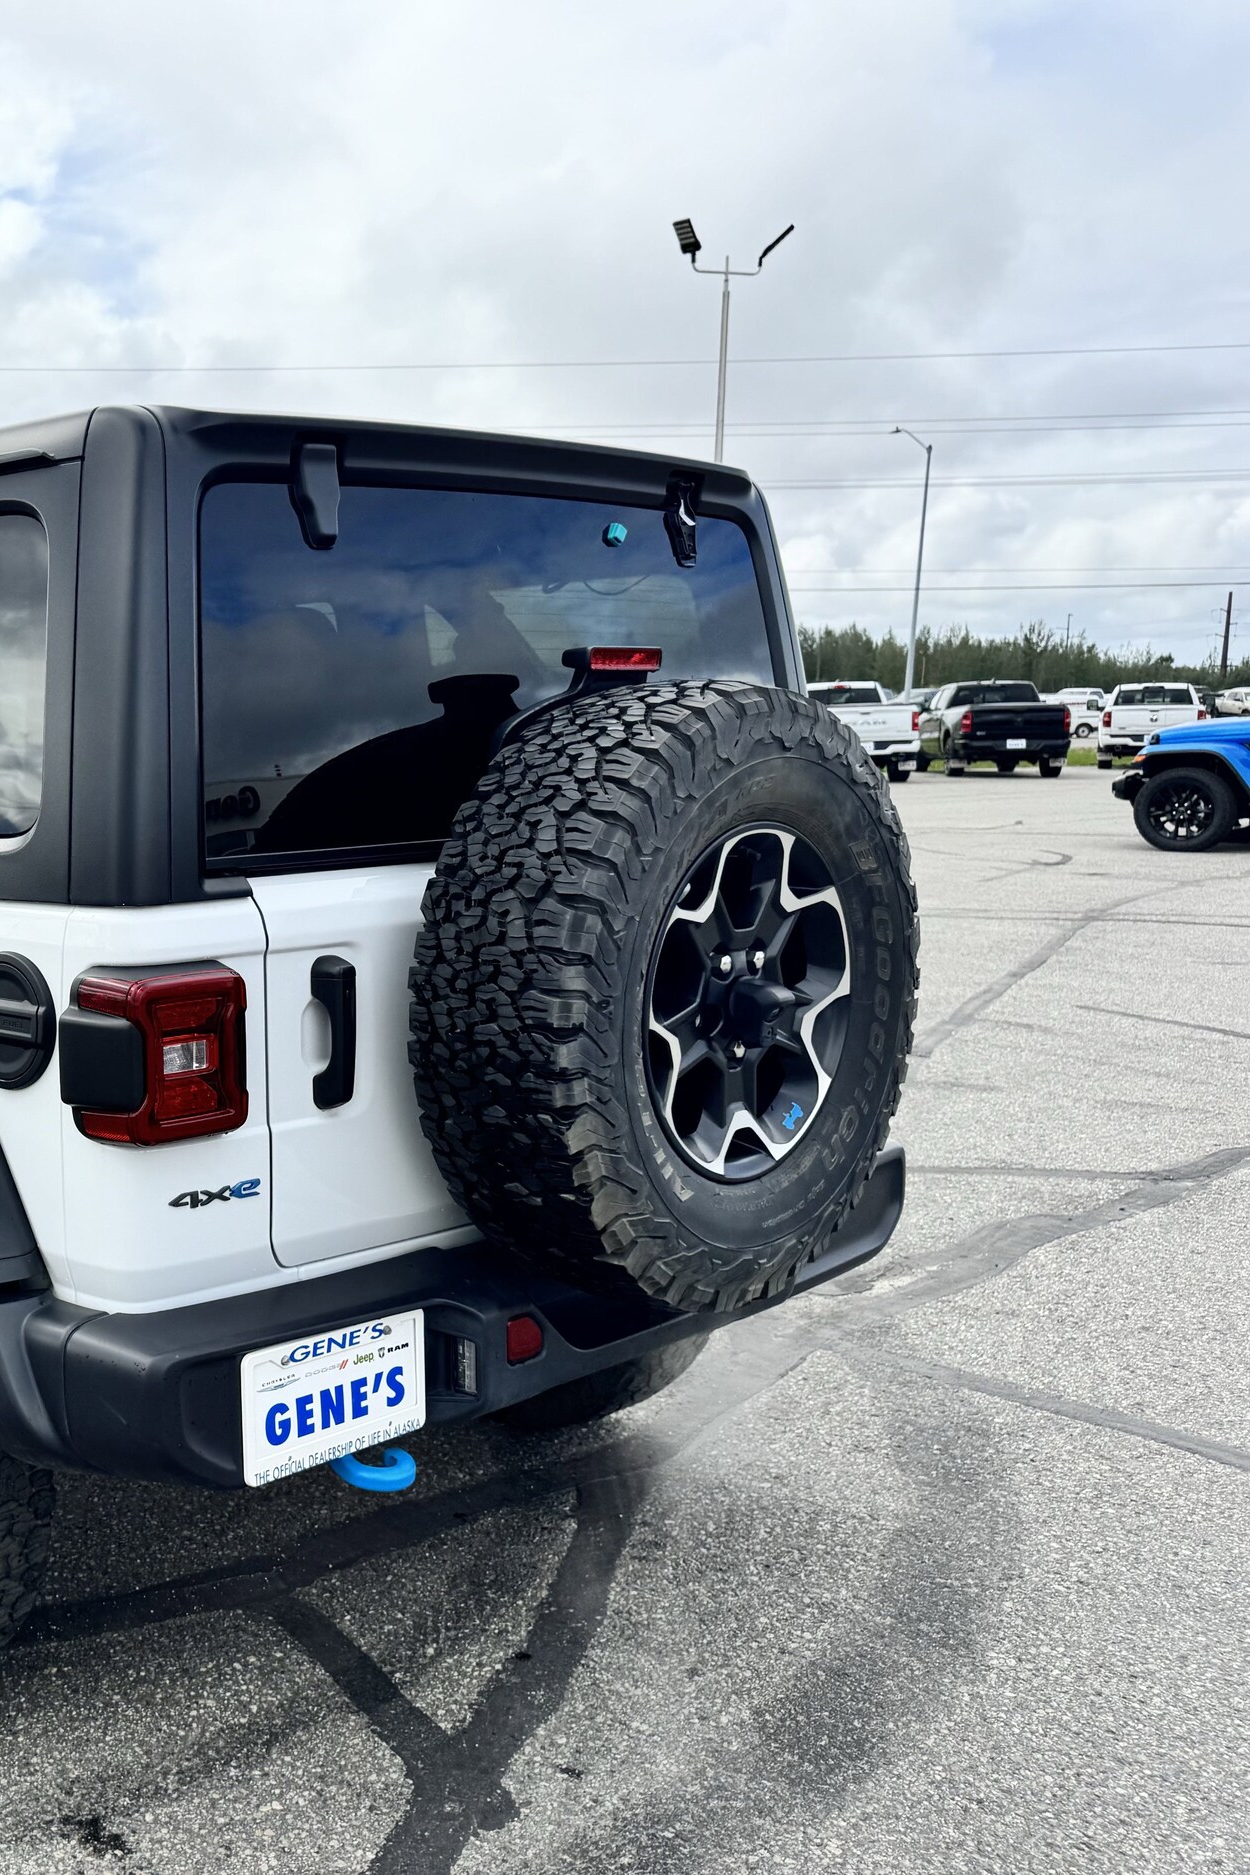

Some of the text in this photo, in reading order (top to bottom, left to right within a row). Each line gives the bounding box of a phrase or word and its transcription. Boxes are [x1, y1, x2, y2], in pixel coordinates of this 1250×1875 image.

[168, 1178, 261, 1209] 4xe
[289, 1322, 384, 1364] GENE'S
[352, 1351, 374, 1366] Jeep
[387, 1342, 409, 1354] RAM
[261, 1373, 296, 1388] CHRYSLER
[265, 1366, 405, 1446] GENE'S
[254, 1418, 421, 1487] THE OFFICIAL DEALERSHIP OF LIFE IN ALASKA
